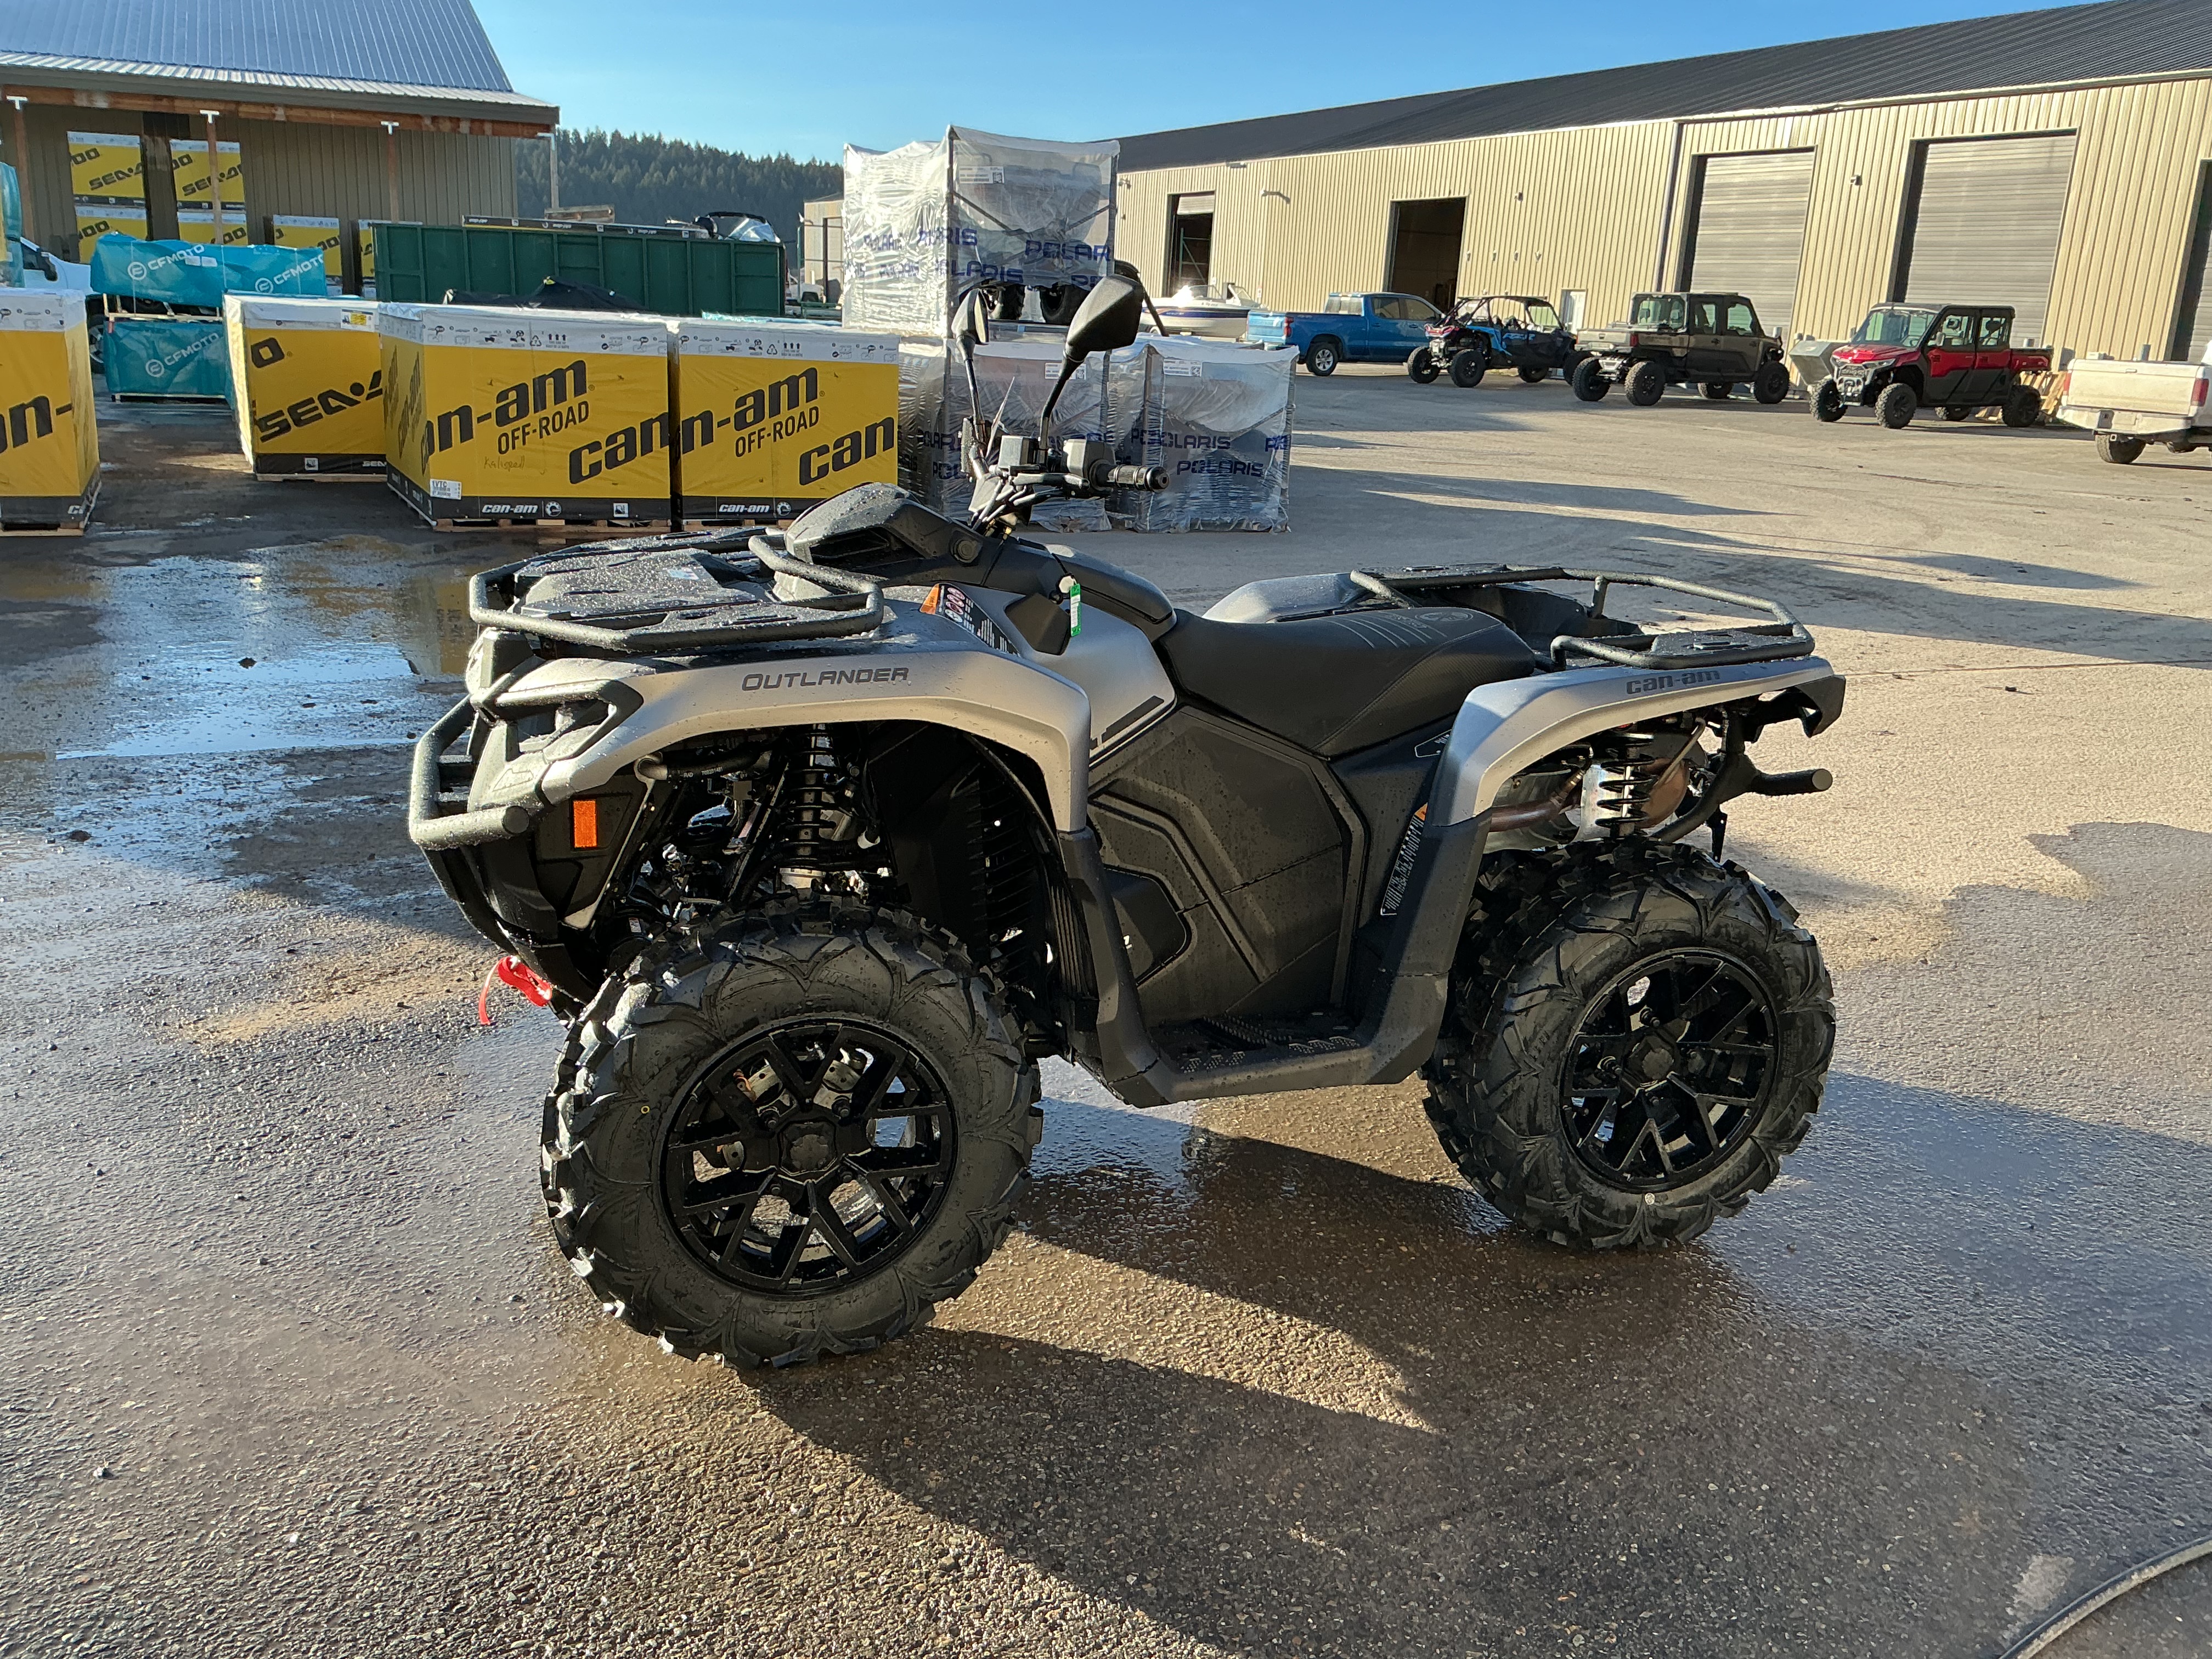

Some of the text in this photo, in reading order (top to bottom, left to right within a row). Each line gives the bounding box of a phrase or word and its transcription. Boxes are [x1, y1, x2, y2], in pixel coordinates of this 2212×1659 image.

[148, 244, 205, 271] CFMOTO
[165, 332, 219, 366] CFMOTO
[0, 395, 72, 454] n-
[498, 400, 589, 455] OFF-ROAD
[735, 406, 819, 457] OFF-ROAD
[569, 412, 669, 484] can
[799, 417, 895, 486] can
[1177, 460, 1264, 477] POLARIS
[482, 504, 538, 514] can-am
[719, 504, 770, 514] can-am
[742, 667, 910, 691] OUTLANDER
[1626, 670, 1721, 695] can-am
